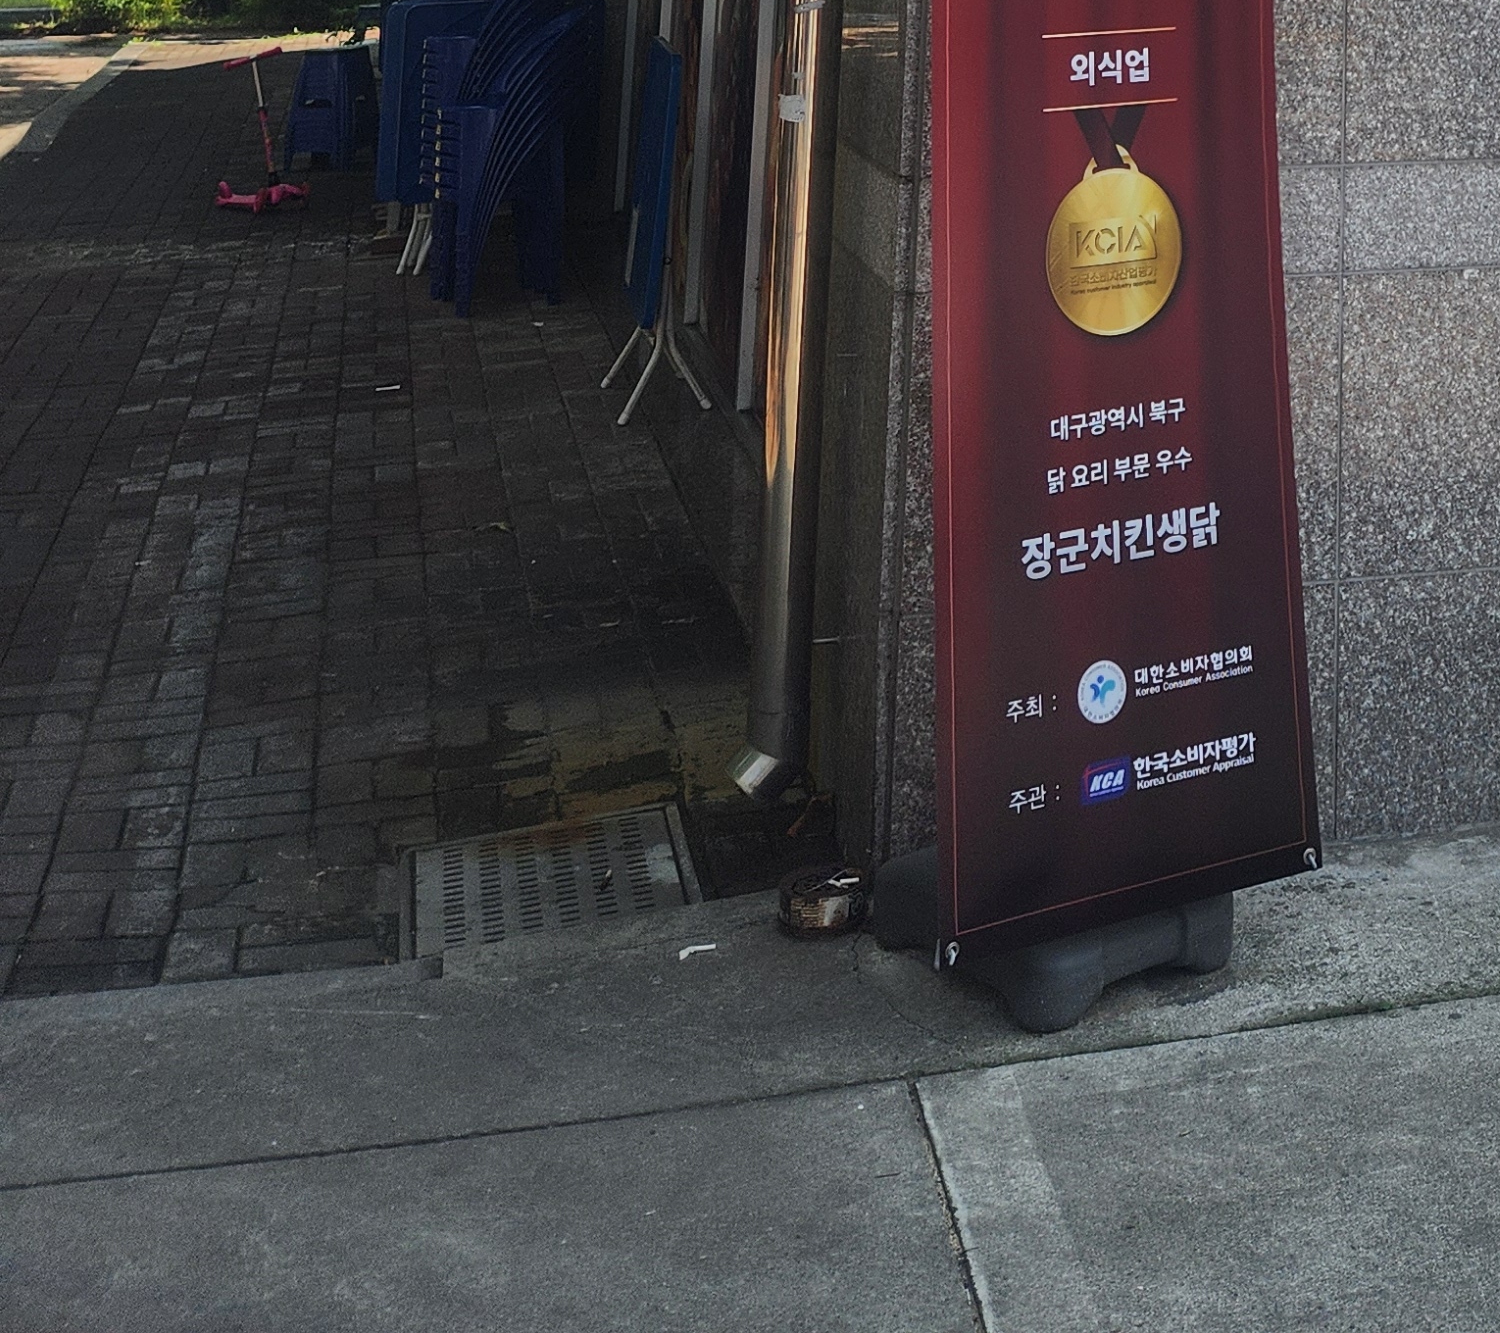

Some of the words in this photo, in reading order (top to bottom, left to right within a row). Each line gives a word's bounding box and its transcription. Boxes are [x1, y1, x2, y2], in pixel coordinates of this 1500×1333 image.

[1069, 46, 1151, 86] 외식업
[1075, 225, 1148, 258] KCIA
[1050, 402, 1144, 441] 대구광역시
[1148, 397, 1186, 424] 북구
[1047, 466, 1066, 495] 닭
[1070, 459, 1109, 489] 요리
[1113, 452, 1151, 482] 부문
[1155, 446, 1193, 475] 우수
[1021, 501, 1221, 581] 장군치킨생닭
[1134, 645, 1253, 686] 대한소비자협의회
[1135, 685, 1161, 698] Korea
[1163, 676, 1202, 692] Consumer
[1205, 664, 1253, 683] Association
[1133, 731, 1257, 779] 한국소비자평가
[1136, 777, 1165, 791] Korea
[1166, 764, 1211, 783] Customer
[1212, 753, 1255, 773] Appraisal
